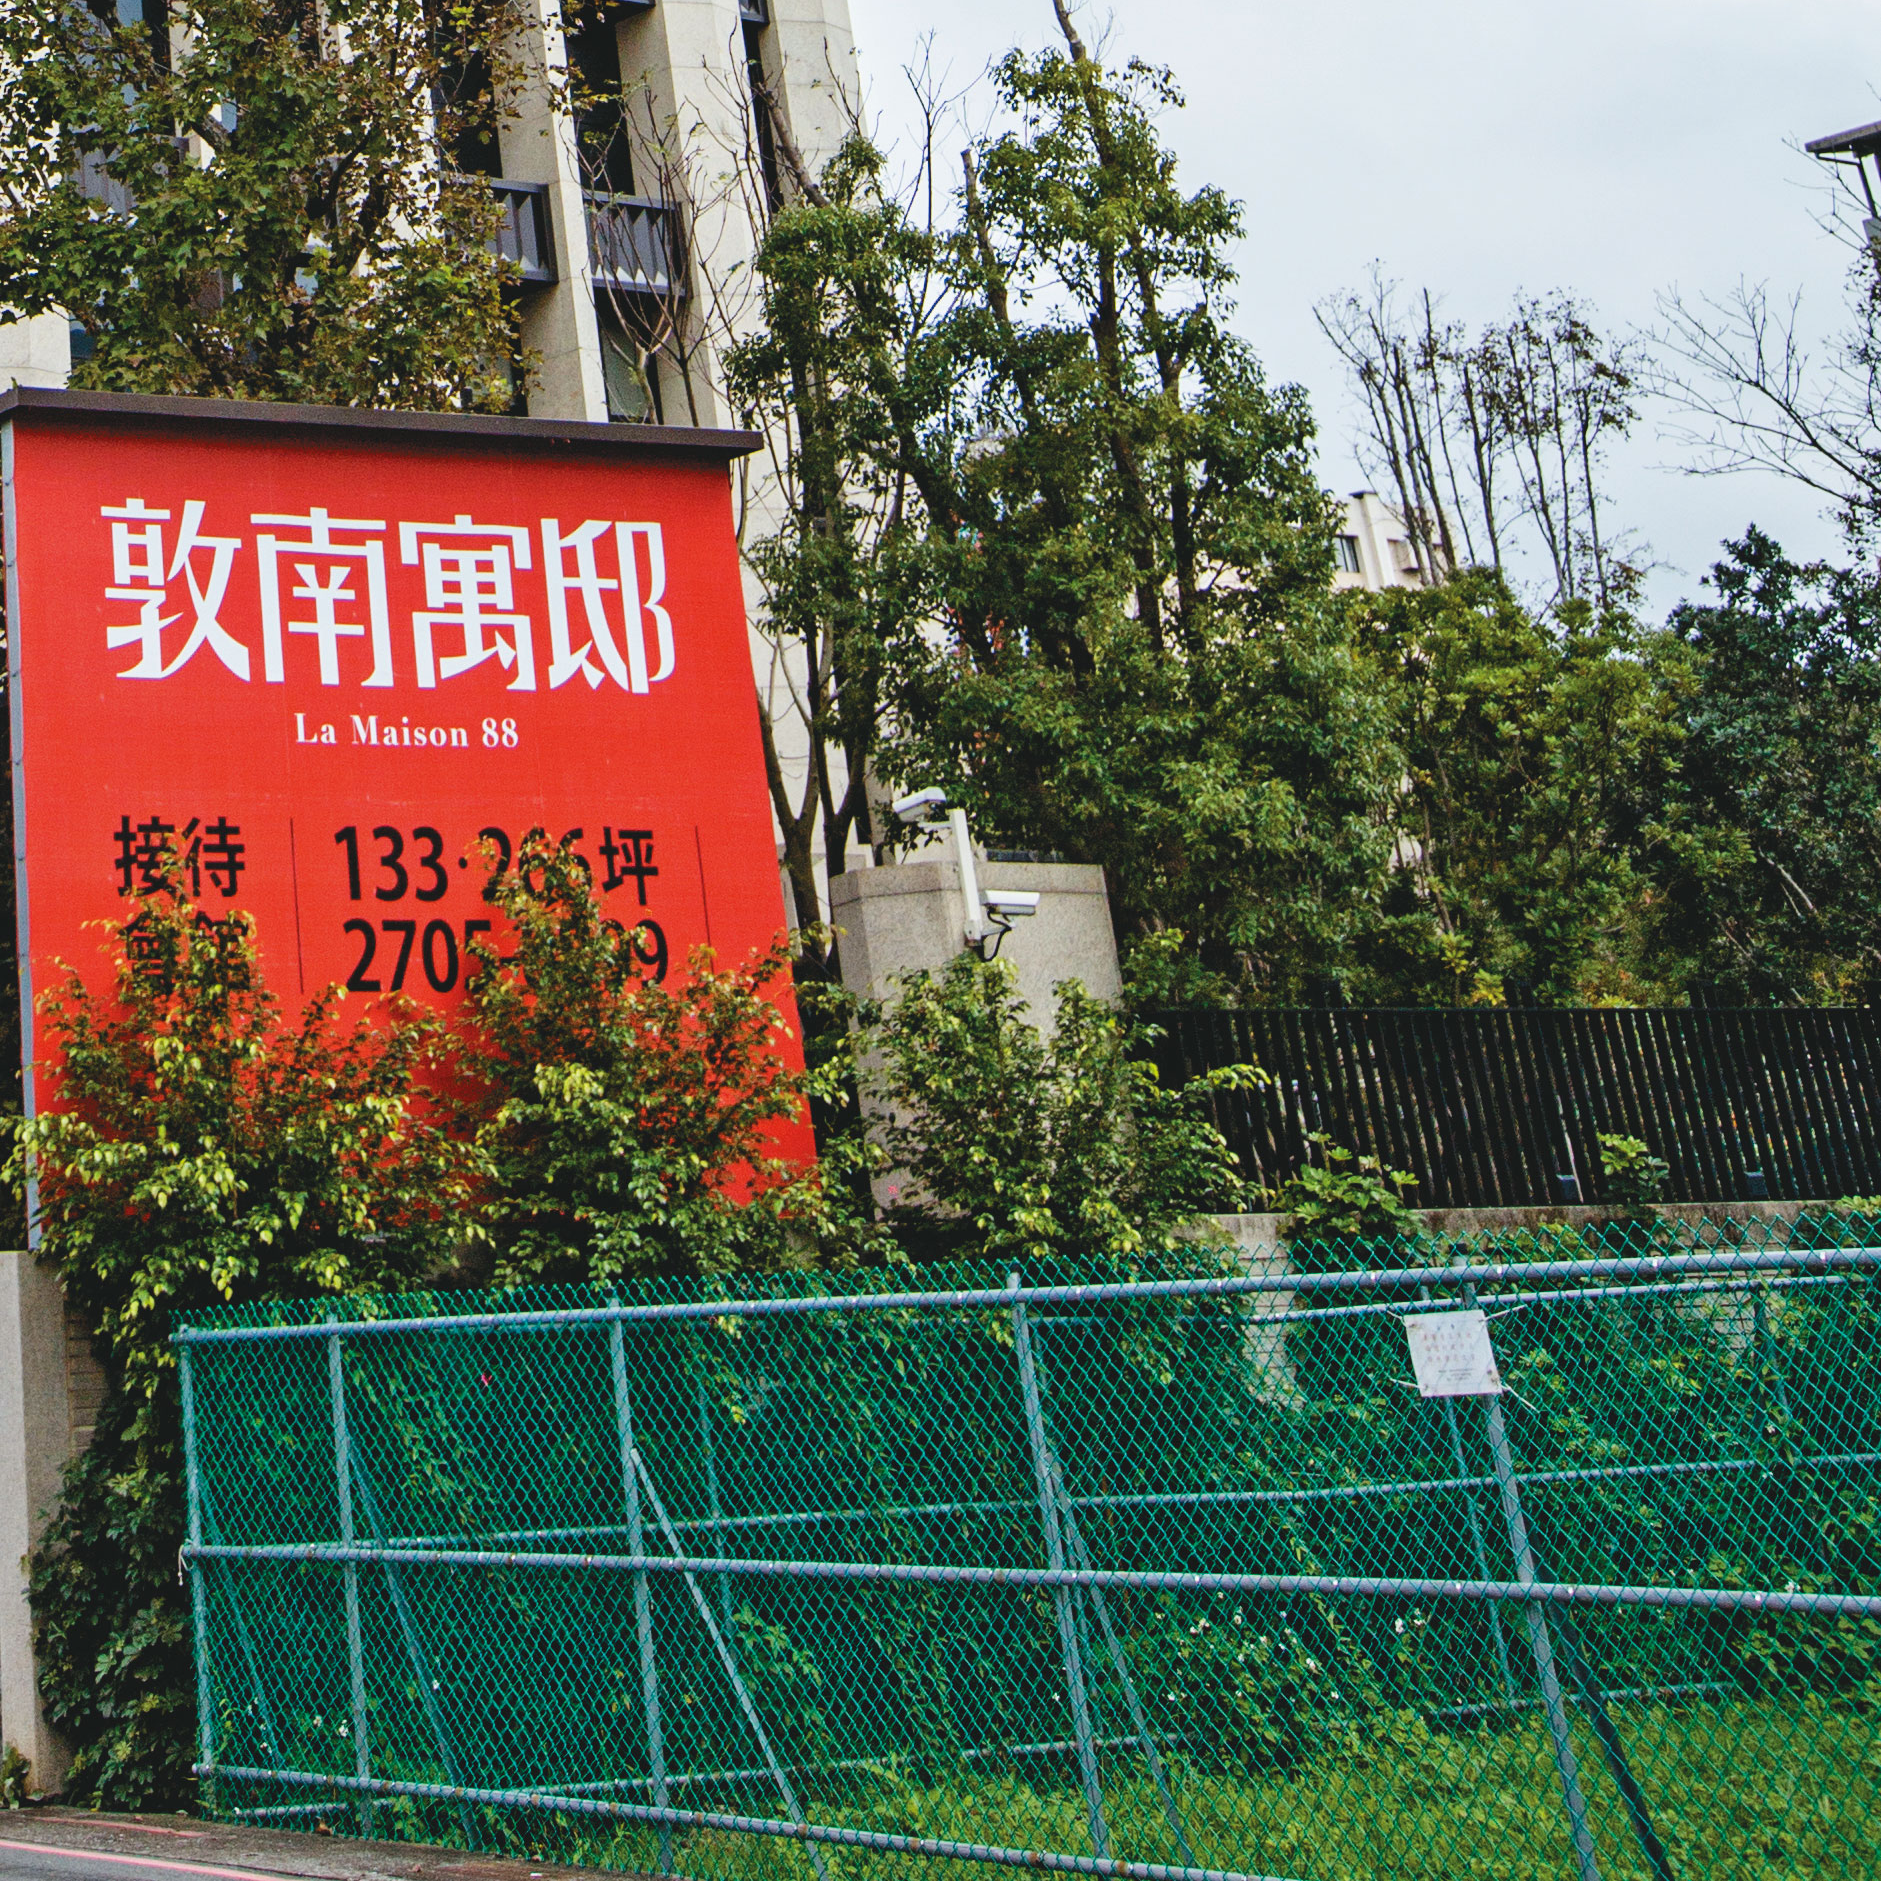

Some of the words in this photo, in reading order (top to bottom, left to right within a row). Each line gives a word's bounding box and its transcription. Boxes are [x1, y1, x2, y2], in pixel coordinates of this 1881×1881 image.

[100, 498, 676, 694] 敦南寓邸
[294, 712, 337, 744] La
[350, 715, 469, 748] Maison
[482, 717, 519, 748] 88
[114, 815, 245, 897] 接待
